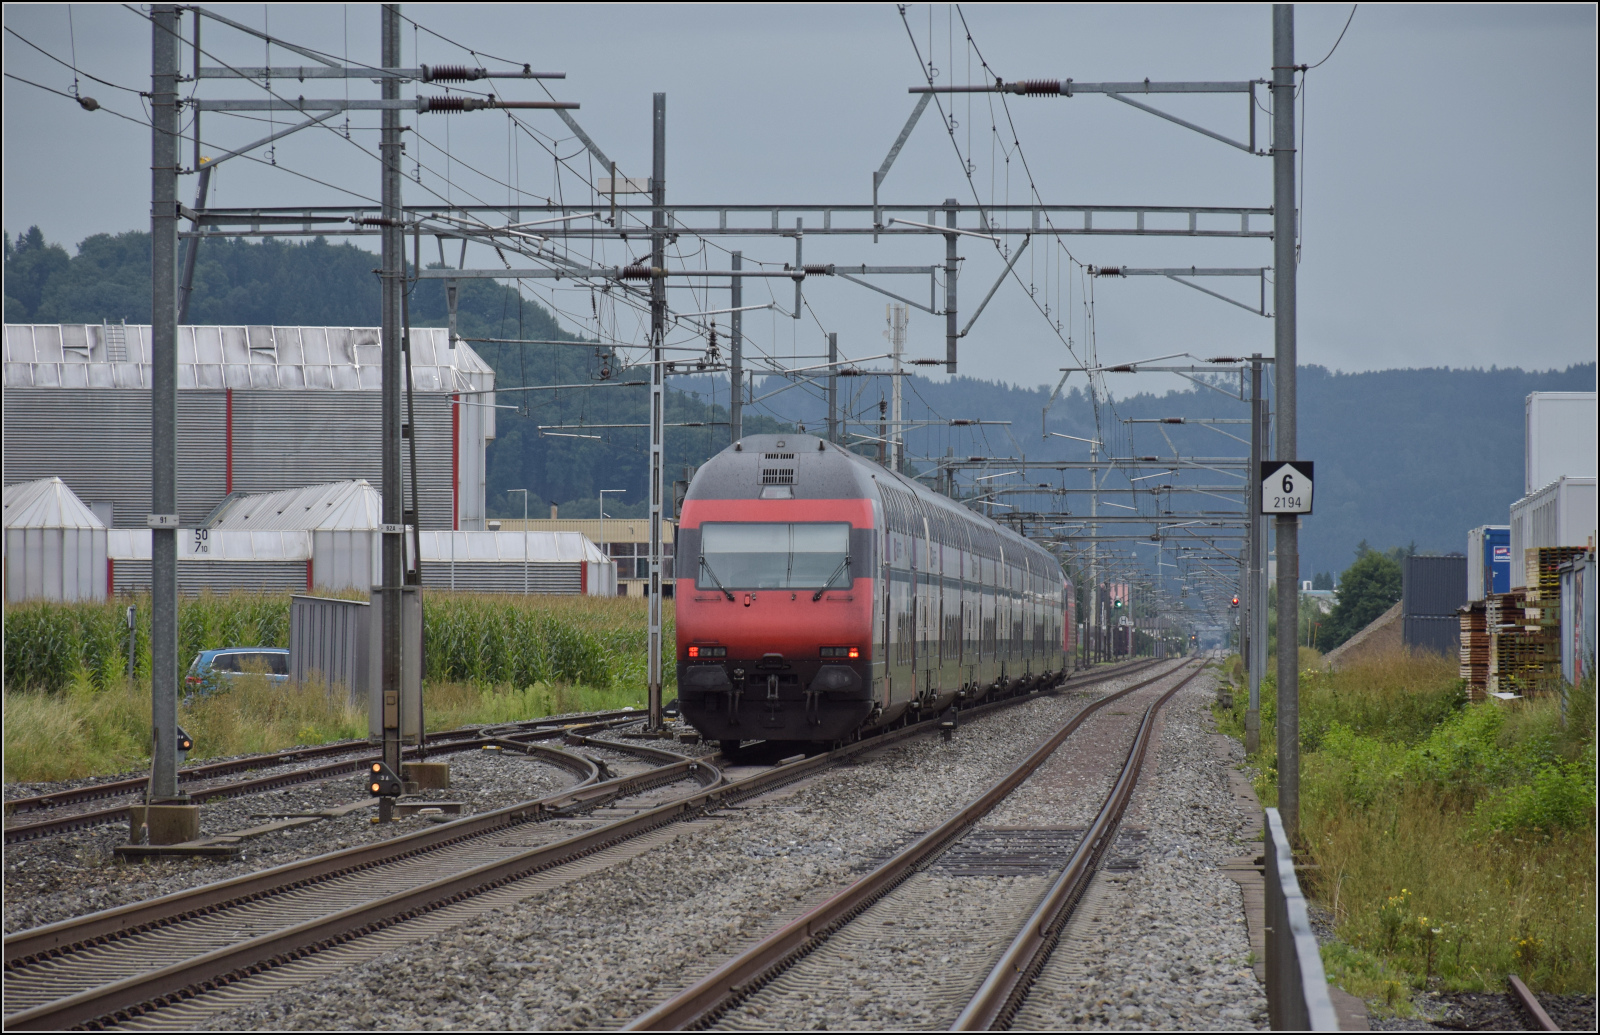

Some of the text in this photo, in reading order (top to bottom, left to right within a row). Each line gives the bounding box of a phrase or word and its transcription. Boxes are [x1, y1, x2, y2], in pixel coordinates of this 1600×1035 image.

[1282, 474, 1293, 493] 6
[1274, 496, 1301, 508] 2194
[195, 529, 208, 540] 50
